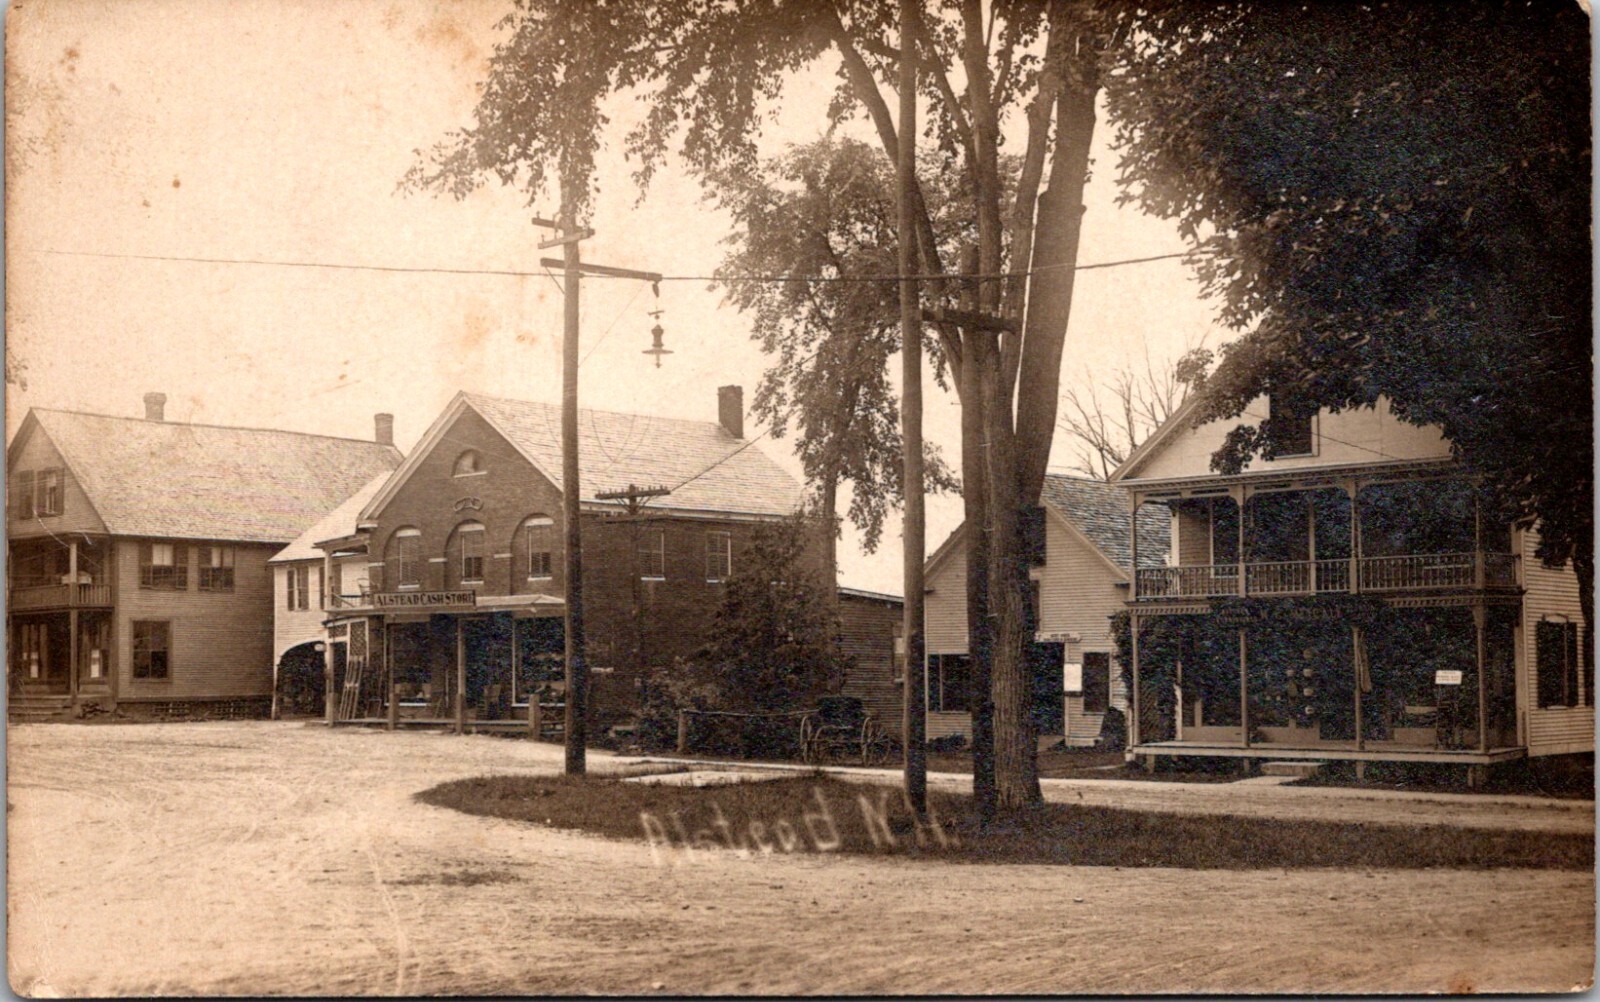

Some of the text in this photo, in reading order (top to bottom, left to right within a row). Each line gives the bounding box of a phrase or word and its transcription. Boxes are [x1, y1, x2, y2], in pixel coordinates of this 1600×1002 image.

[377, 592, 475, 606] ALSTEAD CASH STORE
